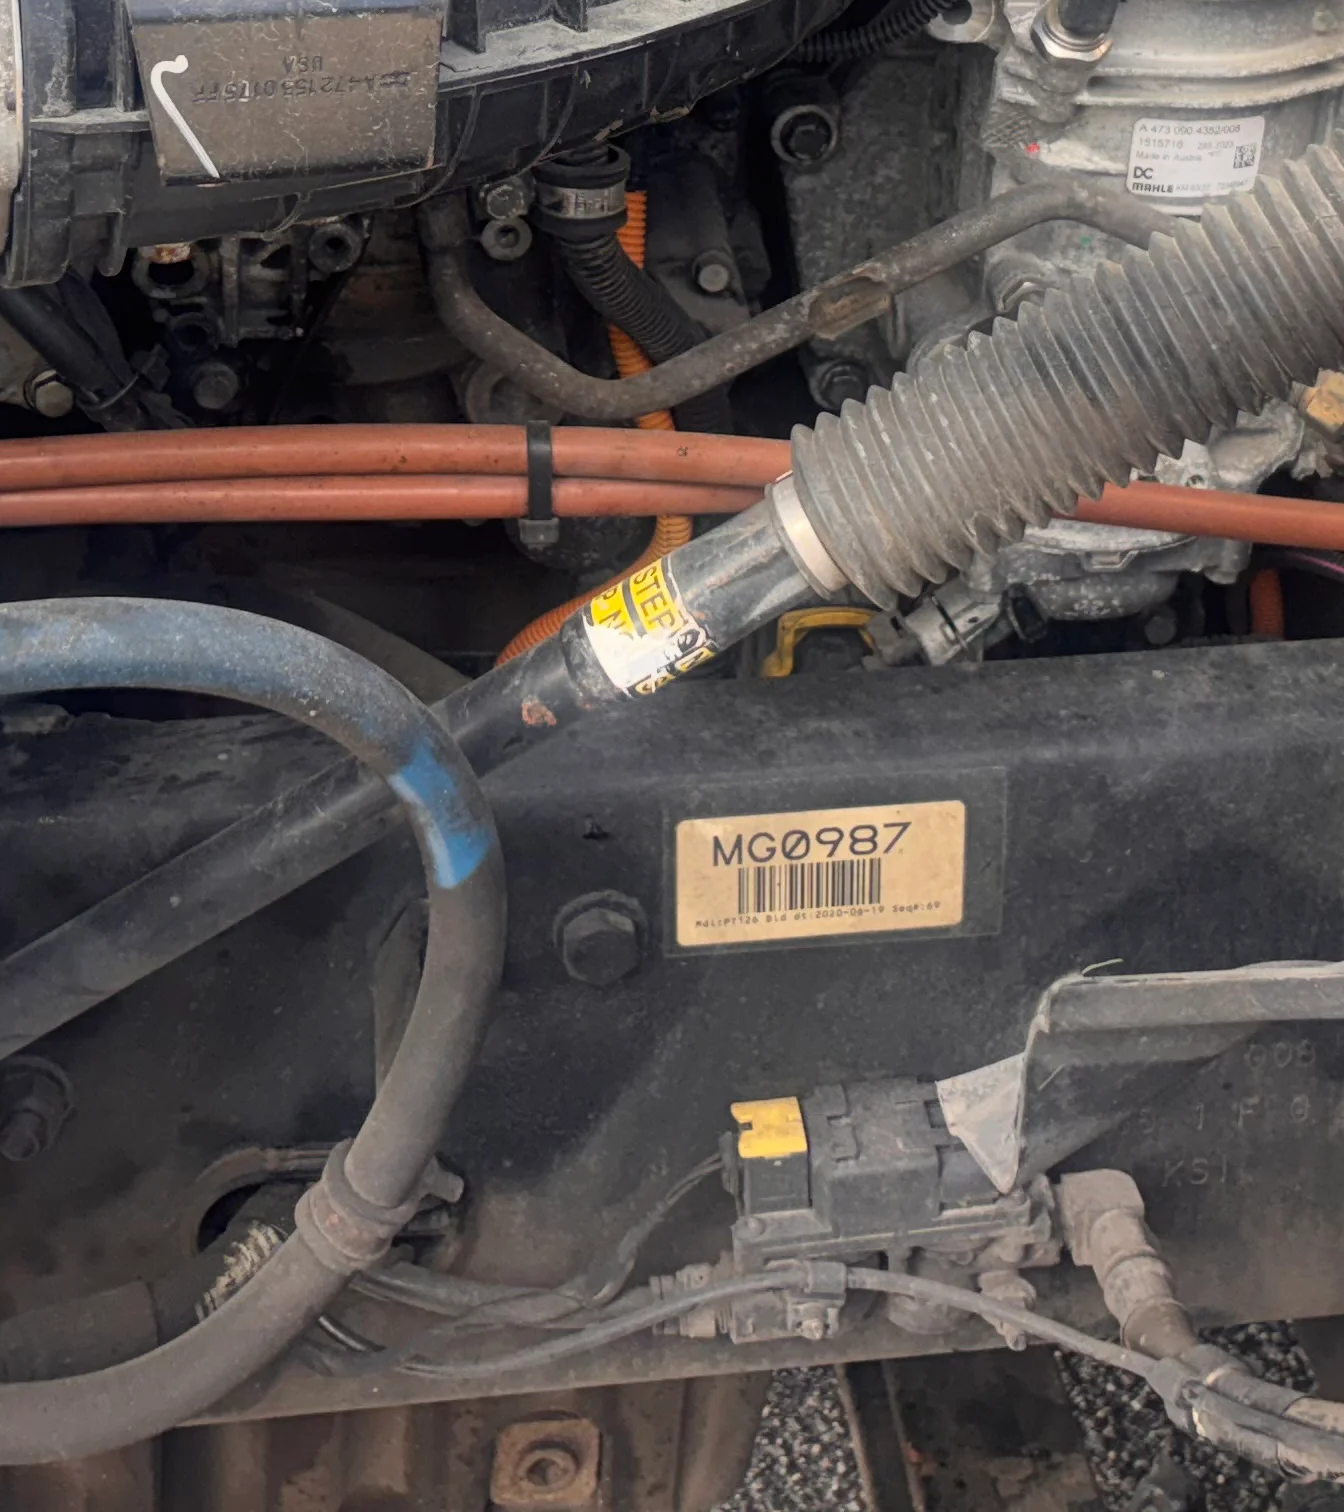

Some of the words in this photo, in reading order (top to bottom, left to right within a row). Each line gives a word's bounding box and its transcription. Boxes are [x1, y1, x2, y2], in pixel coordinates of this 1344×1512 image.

[282, 55, 324, 73] USA
[1139, 124, 1148, 133] A
[1133, 166, 1153, 179] DC
[1132, 182, 1174, 193] MAHLE
[634, 566, 676, 631] STEP
[712, 821, 912, 866] MG0987
[766, 911, 788, 923] Bld
